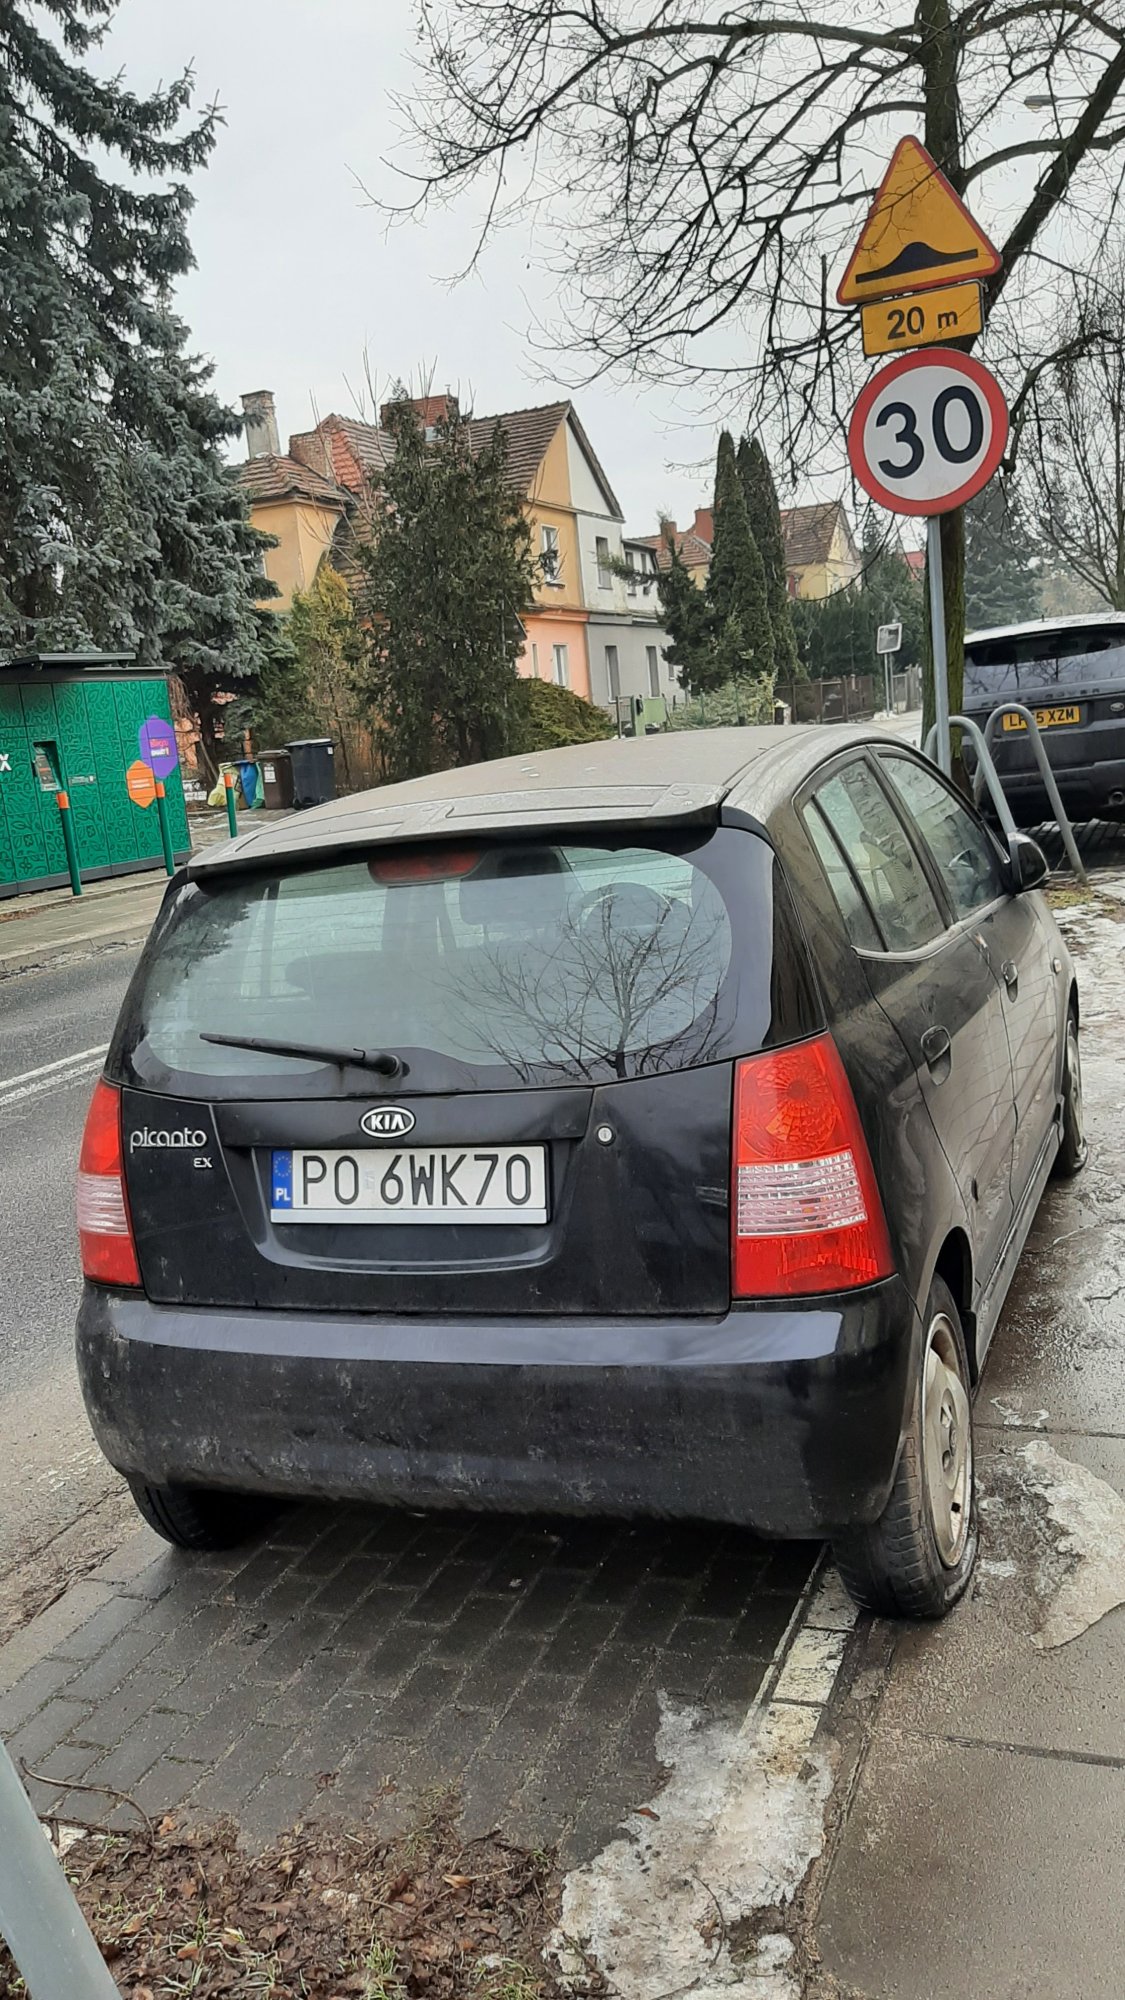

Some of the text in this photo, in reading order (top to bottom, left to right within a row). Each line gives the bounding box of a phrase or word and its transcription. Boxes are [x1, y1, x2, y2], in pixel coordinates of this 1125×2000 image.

[887, 306, 958, 341] 20 m
[875, 385, 984, 479] 30
[1009, 708, 1075, 727] L5 XZM
[370, 1114, 405, 1131] KIA
[130, 1126, 207, 1154] picanto
[193, 1157, 213, 1168] EX
[303, 1155, 359, 1205] PO
[380, 1153, 531, 1206] 6WK70
[275, 1187, 291, 1201] PL
